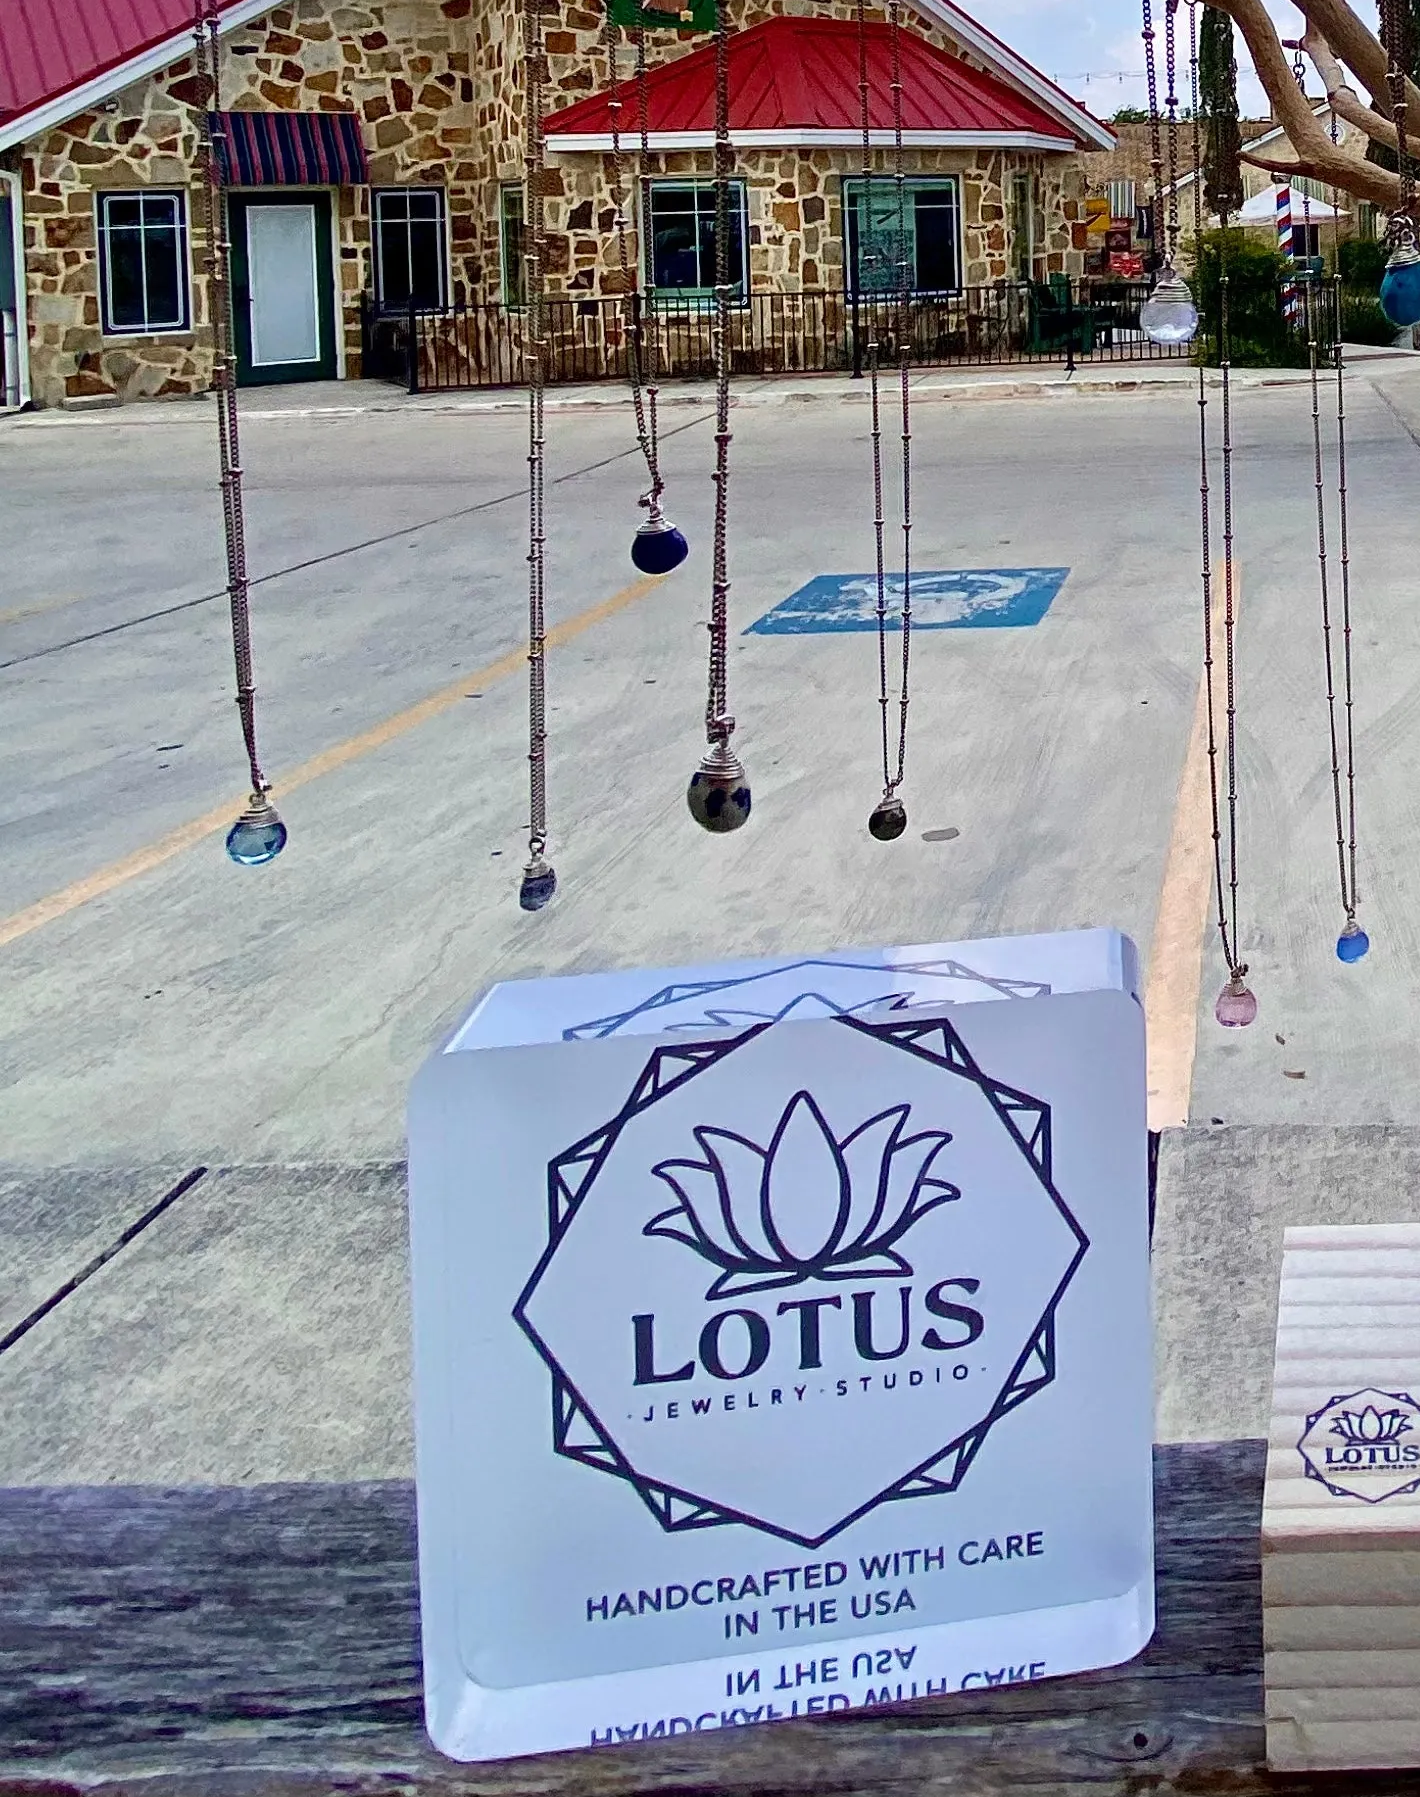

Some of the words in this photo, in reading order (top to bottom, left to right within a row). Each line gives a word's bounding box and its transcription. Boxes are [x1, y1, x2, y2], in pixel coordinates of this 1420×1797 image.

[632, 1277, 984, 1386] LOTUS
[643, 1385, 806, 1422] JEWELRY
[836, 1363, 970, 1397] STUDIO
[1325, 1445, 1420, 1464] LOTUS
[586, 1560, 848, 1622] HANDCRAFTED
[859, 1545, 945, 1581] WITH
[958, 1531, 1044, 1566] CARE
[724, 1610, 760, 1639] IN
[771, 1598, 838, 1631] THE
[851, 1588, 917, 1620] USA
